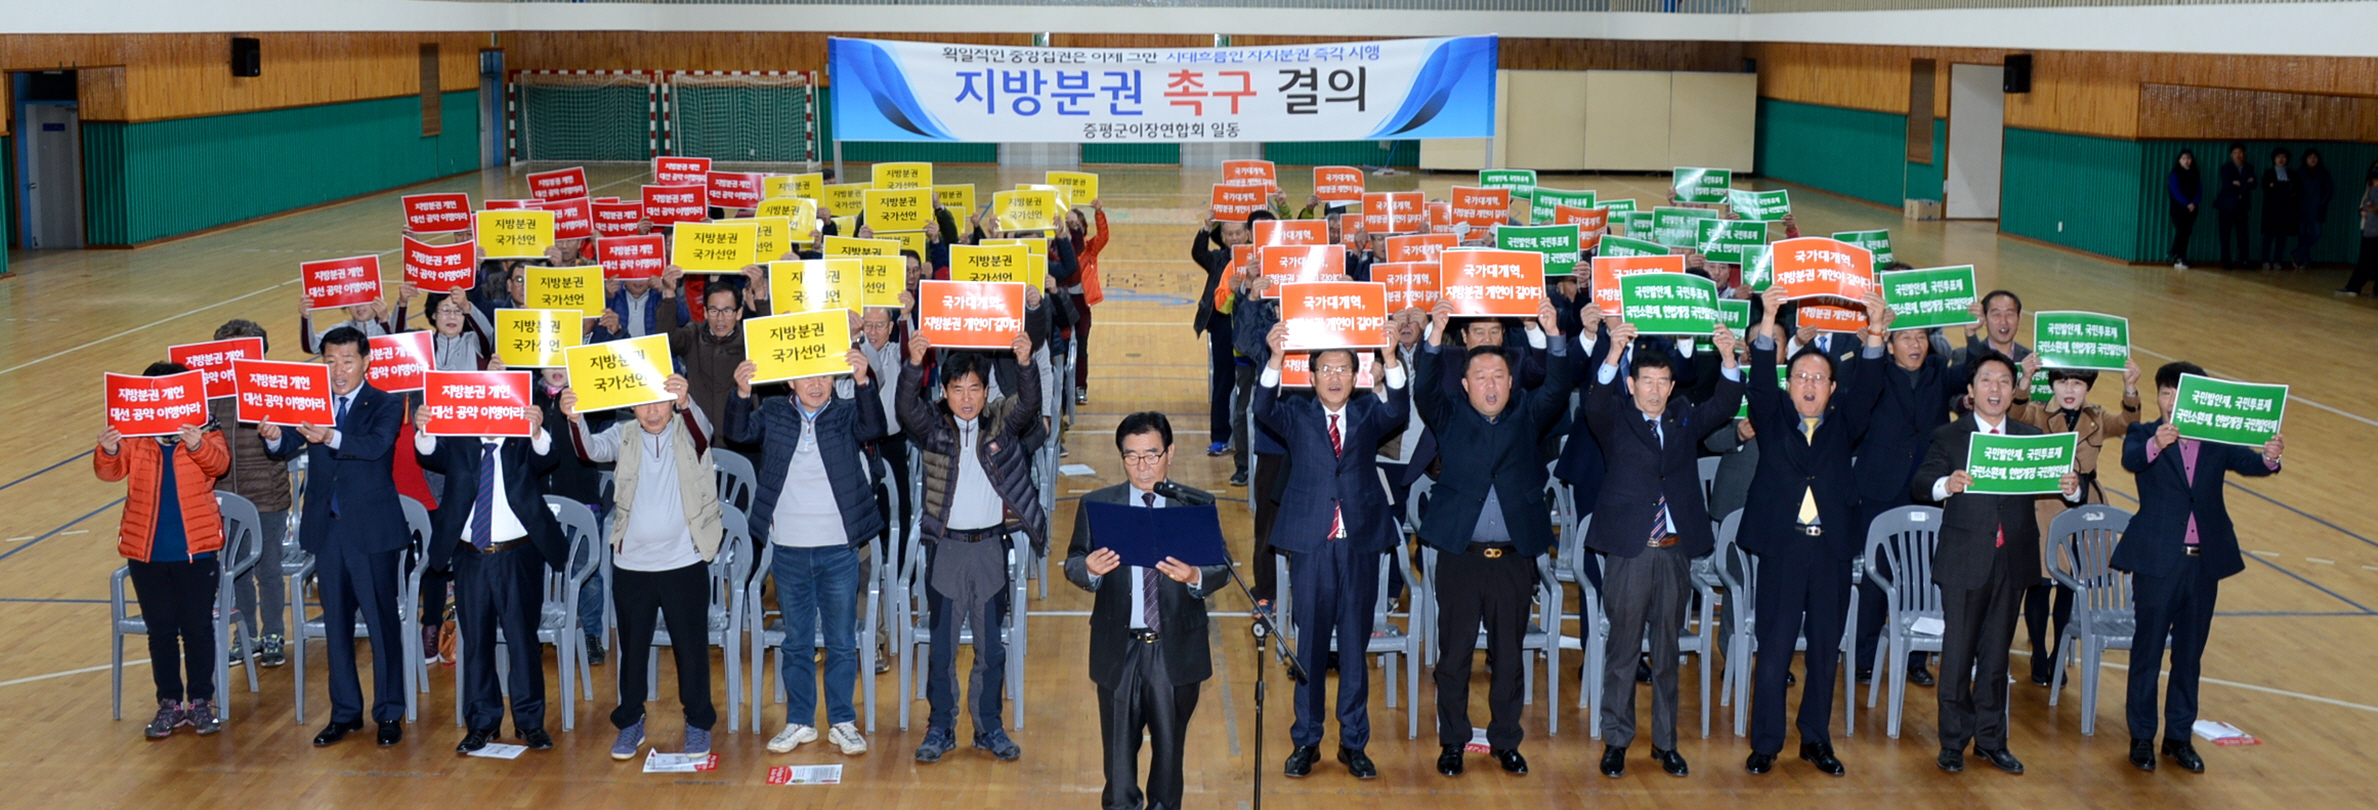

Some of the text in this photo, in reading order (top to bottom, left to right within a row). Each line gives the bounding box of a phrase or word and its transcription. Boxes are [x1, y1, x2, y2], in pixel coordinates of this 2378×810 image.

[1010, 50, 1087, 63] 중앙집권은
[1092, 52, 1122, 63] 이제
[1126, 52, 1157, 63] 그만
[1248, 48, 1309, 62] 자치분권
[1314, 47, 1344, 61] 즉각
[1350, 45, 1379, 60] 시행
[955, 67, 1367, 117] 지방분권 촉구 결의
[1082, 122, 1241, 139] 증평군이장연합회 일동
[886, 169, 918, 178] 지방분권
[652, 194, 694, 203] 지방분권 개헌
[833, 189, 861, 198] 지방분권
[414, 200, 457, 211] 지방분권 개헌
[834, 201, 861, 209] 국가선언
[880, 196, 917, 207] 지방분권
[1008, 197, 1042, 207] 지방분권
[647, 207, 661, 215] 대선
[662, 207, 675, 215] 공약
[765, 205, 800, 215] 지방분권
[881, 212, 917, 221] 국가선언
[1010, 211, 1043, 220] 국가선언
[411, 212, 468, 224] 대선 공약 이행하라
[495, 219, 536, 230] 지방분권
[495, 235, 536, 246] 국가선언
[694, 232, 738, 244] 지방분권
[1540, 236, 1569, 248] 국민투표제
[609, 244, 653, 256] 지방분권 개헌
[693, 249, 736, 260] 국가선언
[411, 250, 461, 265] 지방분권 개헌
[603, 260, 618, 269] 대선
[619, 259, 635, 269] 공약
[968, 255, 1013, 267] 지방분권
[1794, 250, 1855, 268] 국가대개혁,
[314, 266, 364, 281] 지방분권 개헌
[405, 264, 471, 281] 대선 공약 이행하라
[1463, 264, 1525, 278] 국가대개혁,
[541, 277, 584, 289] 지방분권
[1777, 269, 1815, 285] 지방분권
[1817, 269, 1845, 283] 개헌이
[1846, 274, 1872, 289] 길이다
[308, 280, 376, 297] 대선 공약 이행하라
[1445, 286, 1542, 300] 지방분권 개헌이 길이다
[1634, 285, 1710, 302] 국민발안제, 국민투표제
[1895, 278, 1964, 296] 국민발안제, 국민투표제
[541, 294, 584, 306] 국가선언
[1303, 295, 1365, 310] 국가대개혁,
[1920, 299, 1944, 314] 헌법개정
[1626, 305, 1662, 318] 국민소환제,
[1663, 306, 1690, 318] 헌법개정
[924, 317, 962, 330] 지방분권
[1357, 317, 1384, 330] 길이다
[2047, 323, 2118, 338] 국민발안제, 국민투표제
[770, 322, 825, 341] 지방분권
[772, 344, 826, 363] 국가선언
[2038, 340, 2127, 356] 국민소환제, 헌법개정 국민발안제
[185, 351, 223, 366] 지방분권
[370, 365, 389, 379] 공약
[249, 373, 288, 388] 지방분권
[290, 376, 311, 390] 개헌
[118, 385, 185, 400] 지방분권 개헌
[442, 384, 511, 399] 지방분권 개헌
[243, 393, 326, 411] 대선 공약 이행하라
[2192, 390, 2272, 412] 국민발안제, 국민투표제
[111, 402, 201, 421] 대선 공약 이행하라
[432, 405, 525, 420] 대선 공약 이행하라
[2176, 409, 2278, 433] 국민소환제, 헌법개정 국민발안제
[1984, 446, 2063, 461] 국민발안제, 국민투표제
[1971, 464, 2070, 480] 국민소환제, 헌법개정 국민발안제
